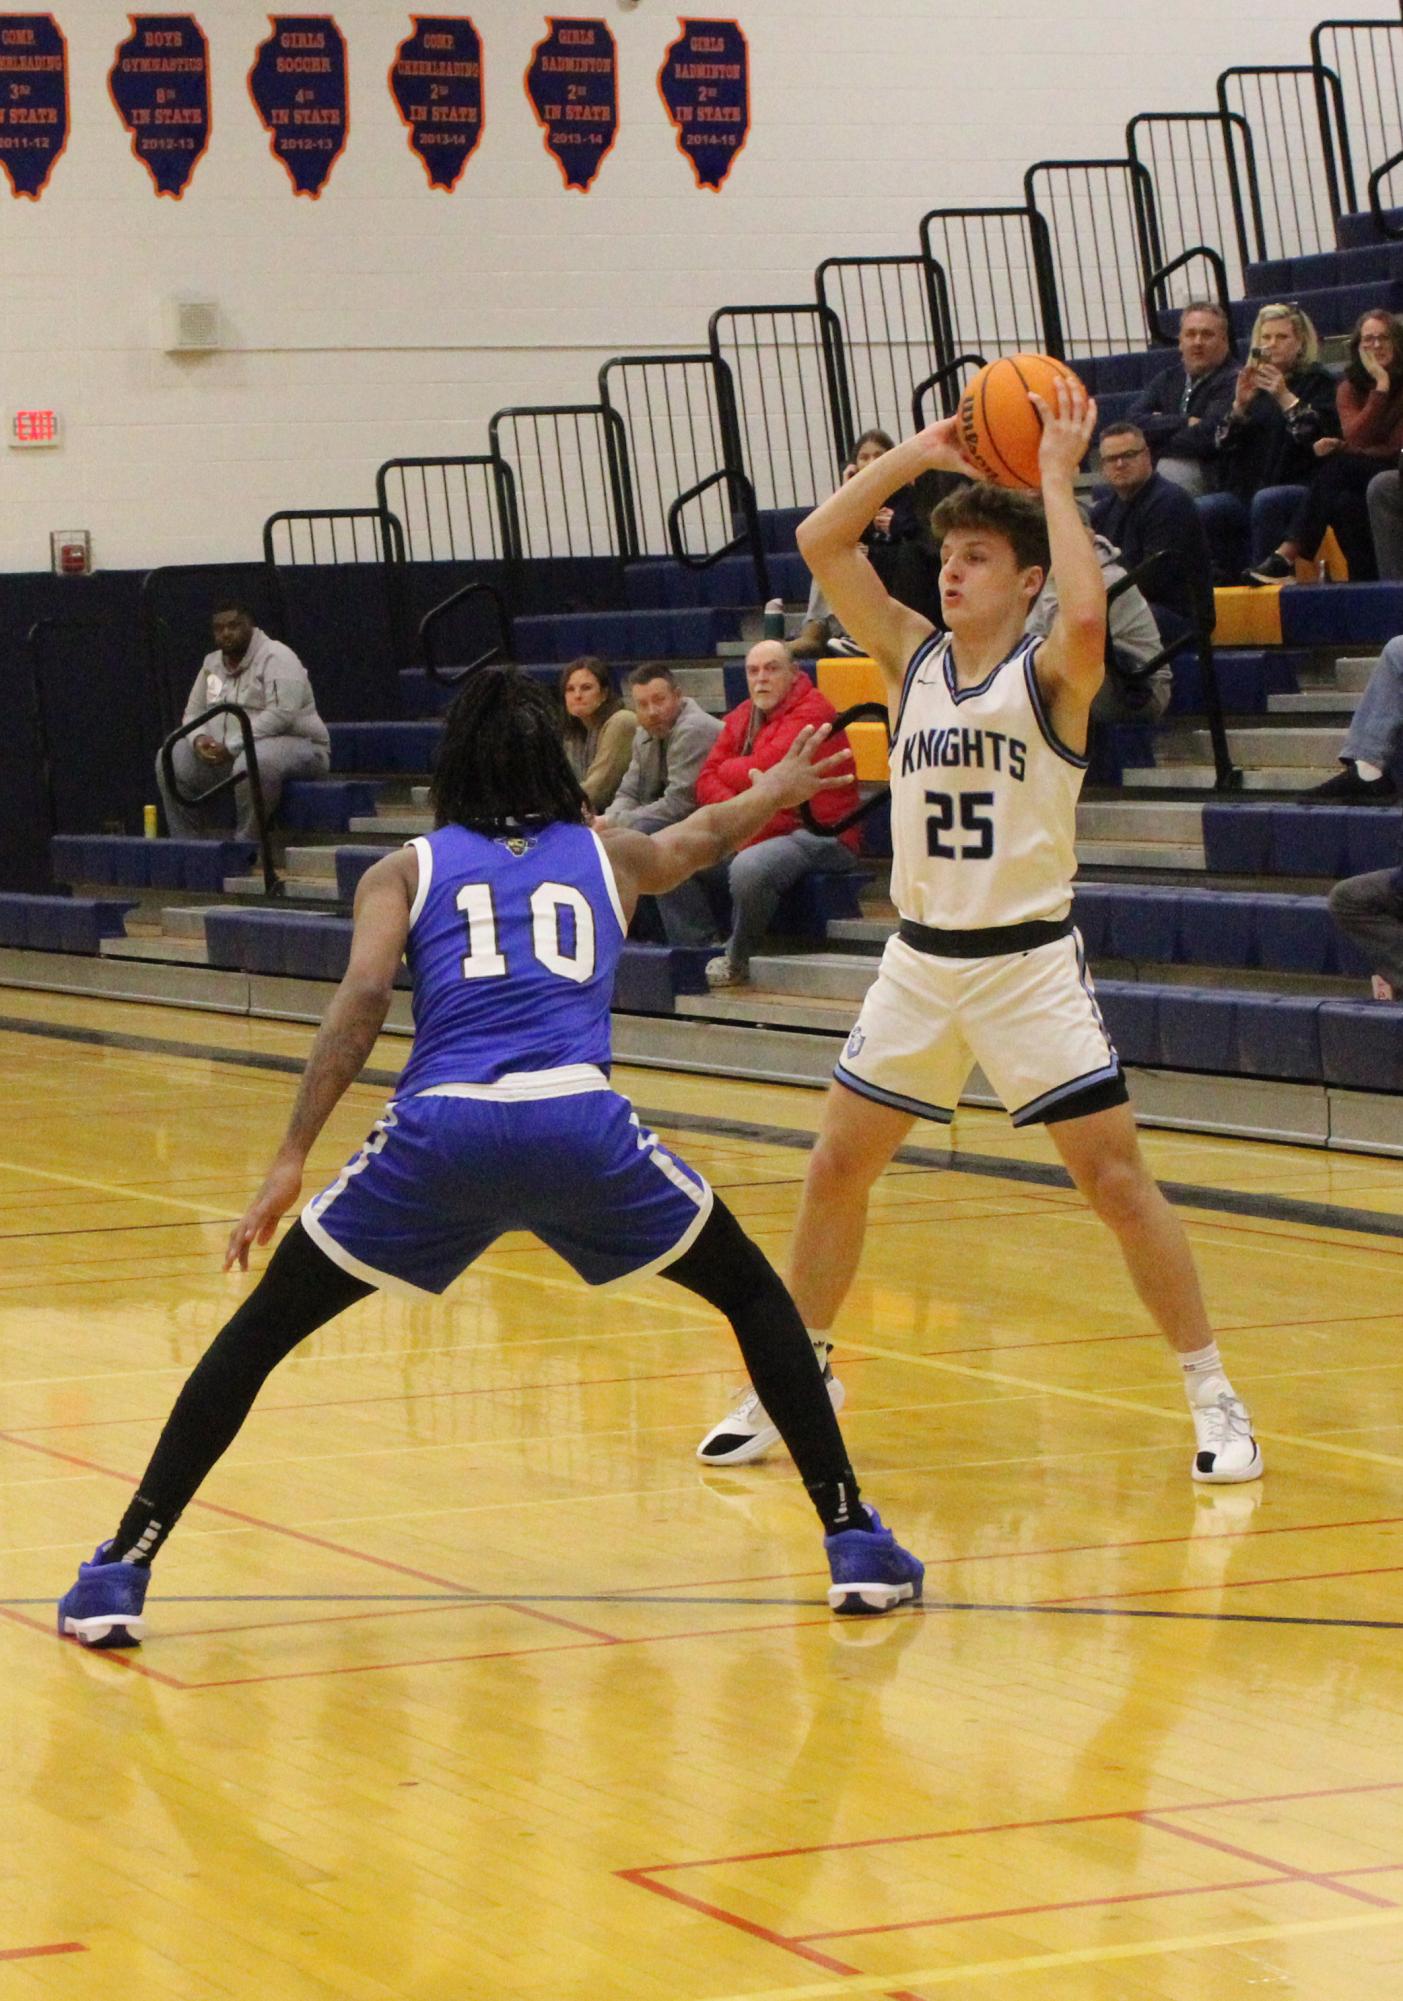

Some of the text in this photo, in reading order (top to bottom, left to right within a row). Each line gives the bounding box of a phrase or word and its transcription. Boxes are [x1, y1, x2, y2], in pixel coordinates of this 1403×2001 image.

[144, 31, 182, 47] BOYS
[281, 32, 325, 48] GIRLS
[558, 29, 595, 45] GIRLS
[690, 36, 725, 52] GIRLS
[122, 57, 203, 73] GYMNASTICS
[276, 57, 332, 73] SOCCER
[398, 60, 479, 77] CHEERLEADING
[542, 56, 611, 72] BADMINTON
[675, 63, 741, 79] BADMINTON
[9, 108, 57, 124] STATE
[131, 108, 202, 124] IN STATE
[271, 109, 340, 125] IN STATE
[410, 105, 477, 122] IN STATE
[543, 105, 611, 121] IN STATE
[675, 106, 741, 122] IN STATE
[141, 138, 194, 150] 2012-13
[280, 139, 333, 150] 2012-13
[686, 134, 737, 146] 2014-15
[16, 410, 54, 441] EXIT
[901, 727, 1027, 782] KNIGHTS
[925, 790, 994, 860] 25
[455, 881, 595, 984] 10
